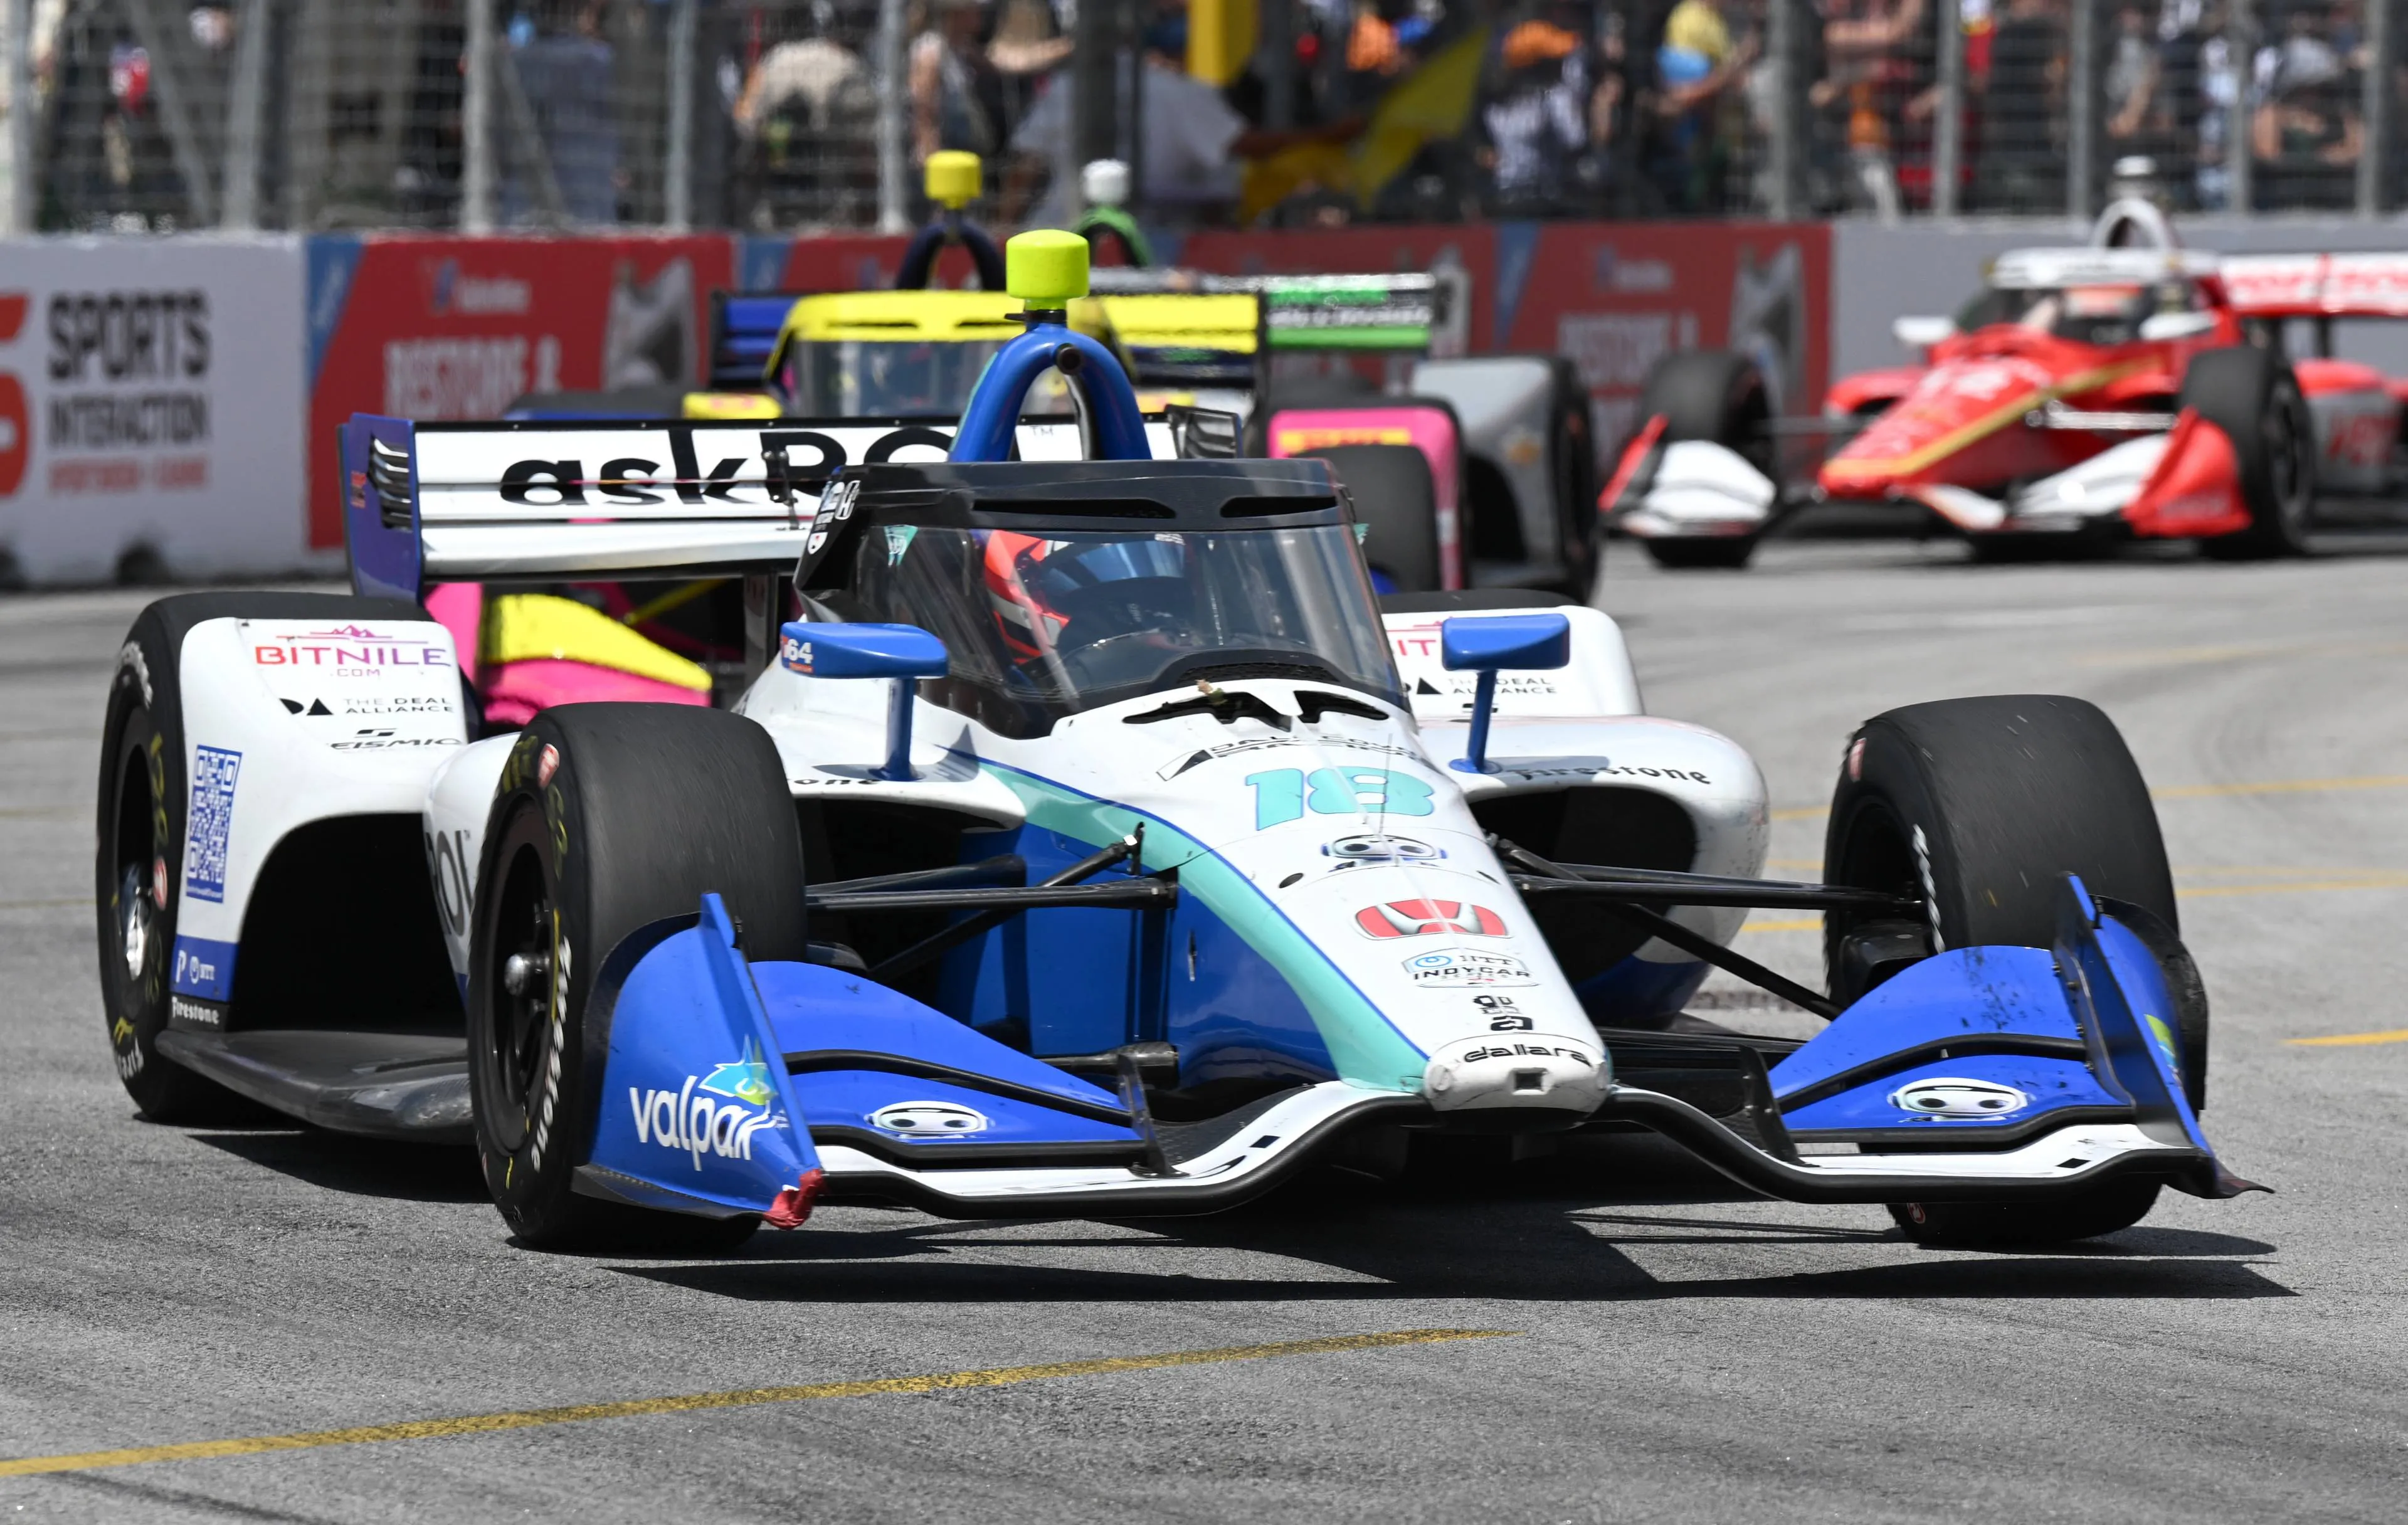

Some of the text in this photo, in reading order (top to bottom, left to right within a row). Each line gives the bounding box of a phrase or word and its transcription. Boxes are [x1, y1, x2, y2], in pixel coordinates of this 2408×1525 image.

[49, 290, 210, 381] SPORTS
[48, 393, 209, 447] INTERACTION
[255, 646, 452, 667] BITNILE
[1448, 678, 1478, 686] TH
[1453, 687, 1558, 695] ALANCE
[344, 697, 452, 705] THE DEAL
[346, 706, 455, 714] ALLIANCE
[1507, 766, 1711, 784] Firestone
[1245, 766, 1435, 831] 18
[1413, 966, 1531, 980] INDYCAR
[172, 996, 219, 1025] Firestone
[1464, 1043, 1593, 1067] dallara
[629, 1075, 776, 1171] valpar
